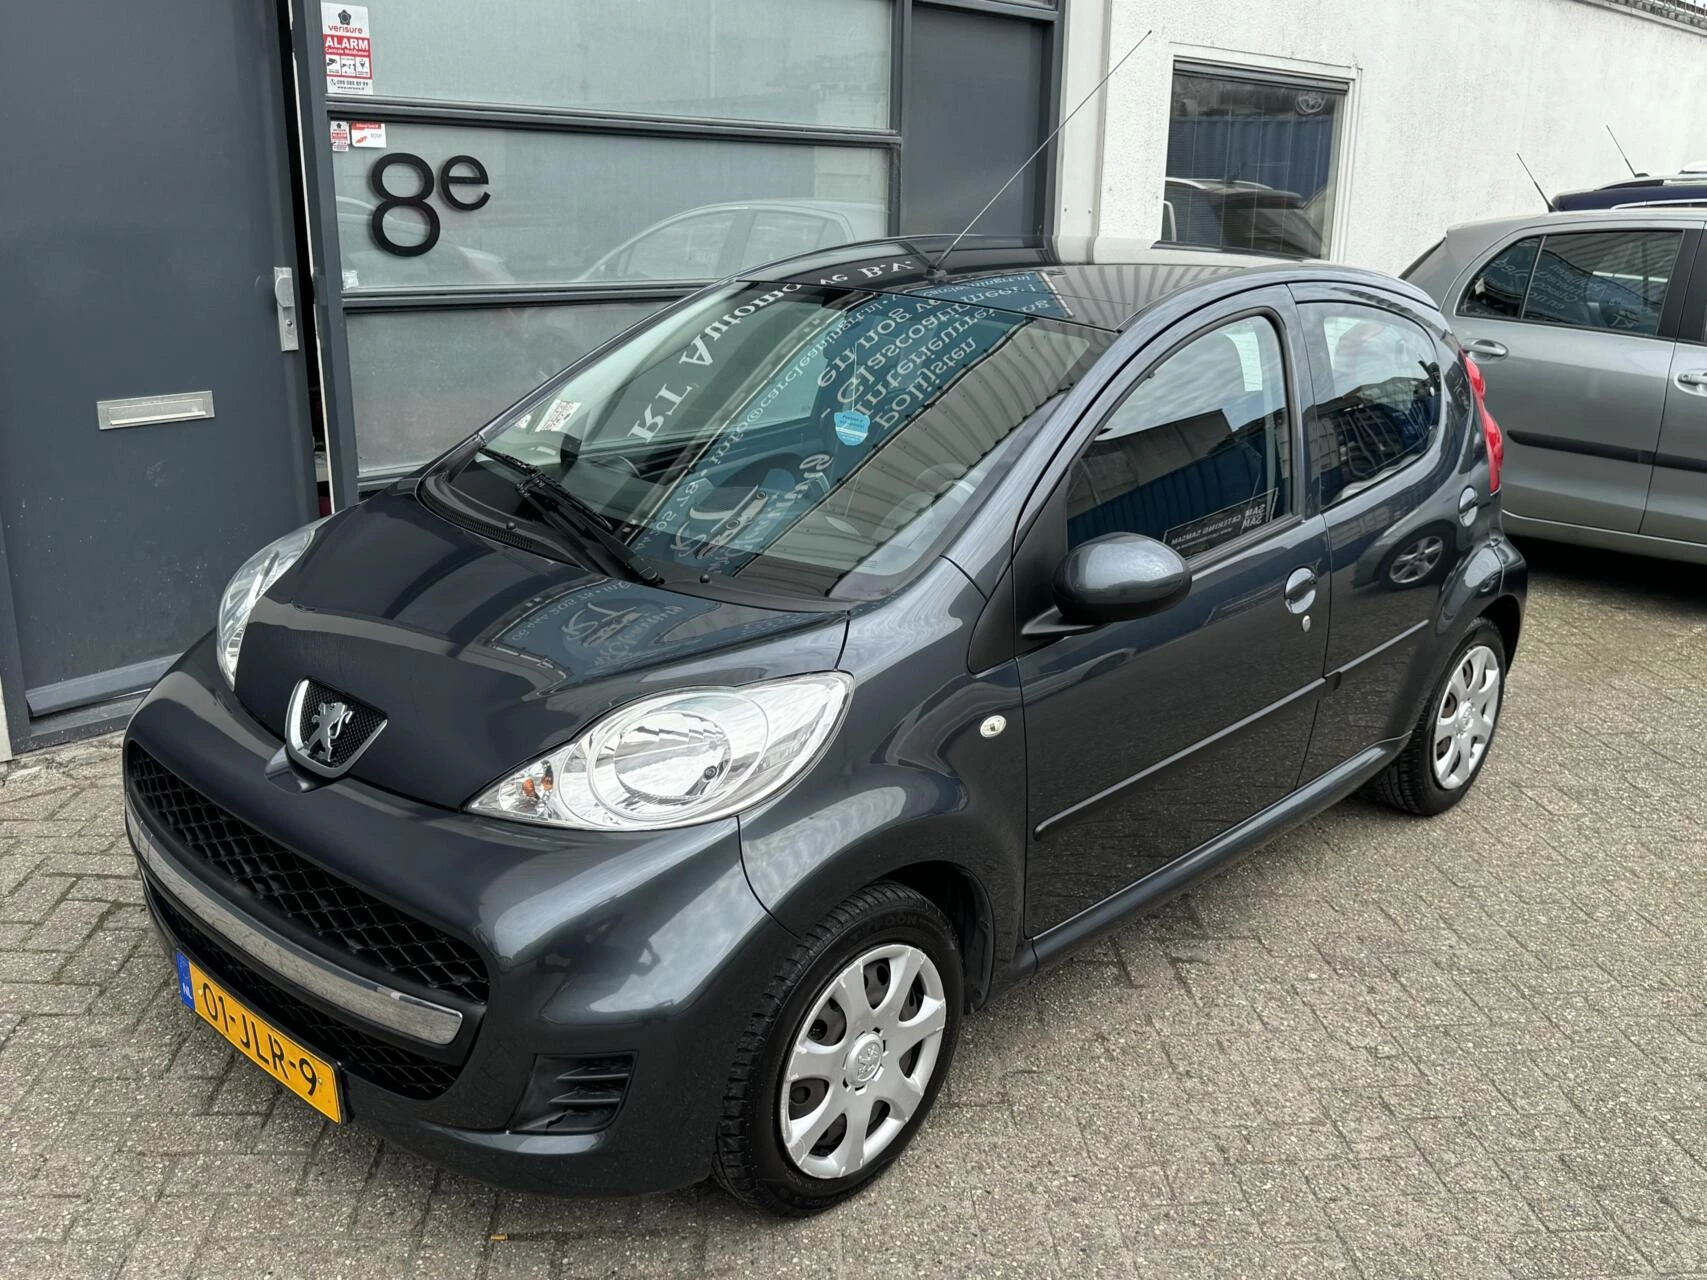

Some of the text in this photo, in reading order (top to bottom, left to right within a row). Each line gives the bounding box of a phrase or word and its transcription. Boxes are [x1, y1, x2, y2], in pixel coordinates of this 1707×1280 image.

[325, 36, 369, 51] ALARM
[328, 25, 363, 34] verisure
[372, 152, 491, 257] 8e
[203, 982, 317, 1096] 01-JLR-9
